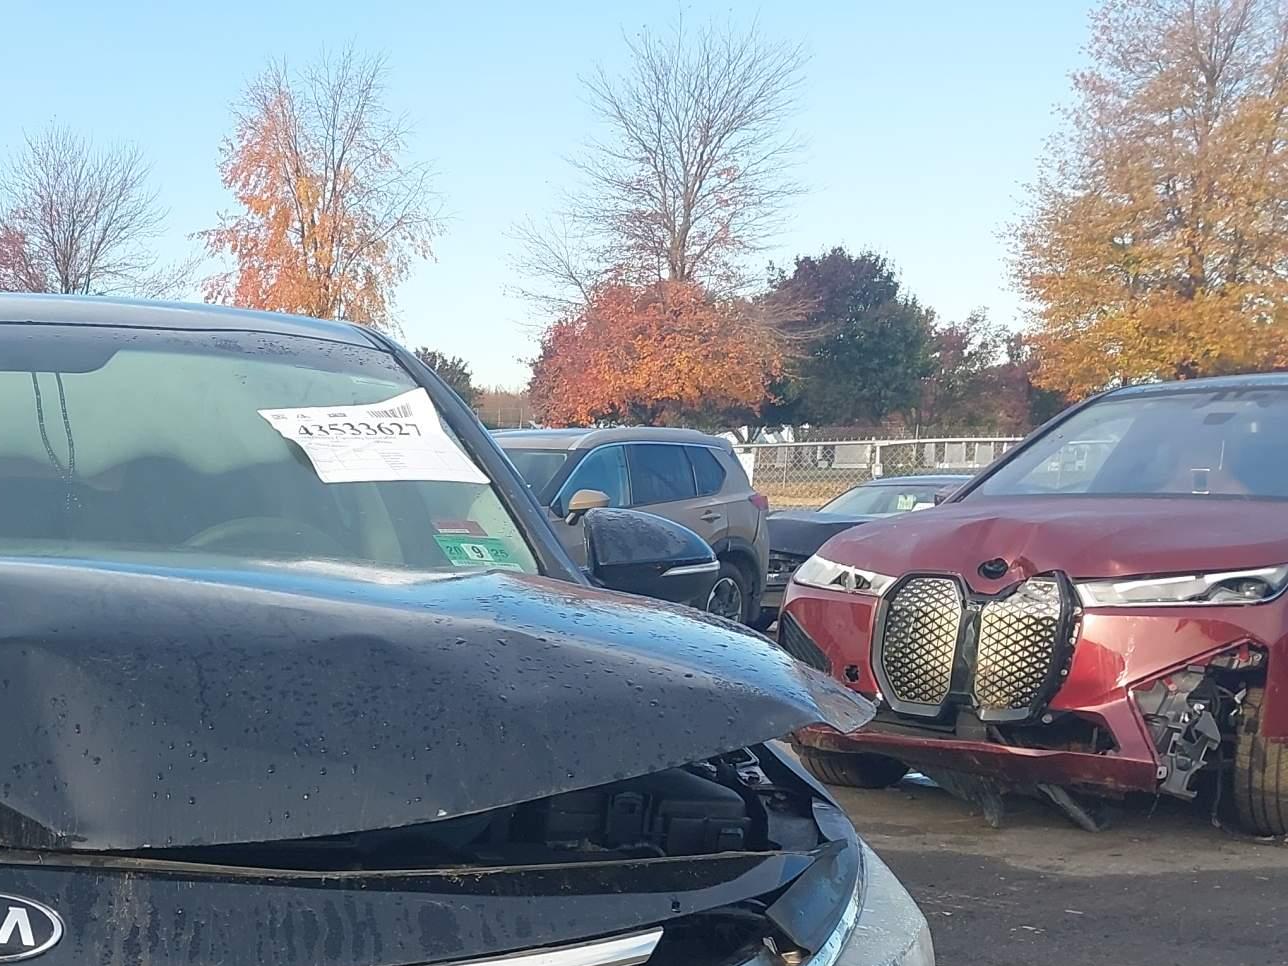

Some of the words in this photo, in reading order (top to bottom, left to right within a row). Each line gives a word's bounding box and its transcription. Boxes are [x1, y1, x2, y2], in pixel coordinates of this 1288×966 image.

[298, 422, 421, 436] 43533627
[471, 545, 484, 558] 9
[491, 548, 509, 558] 25
